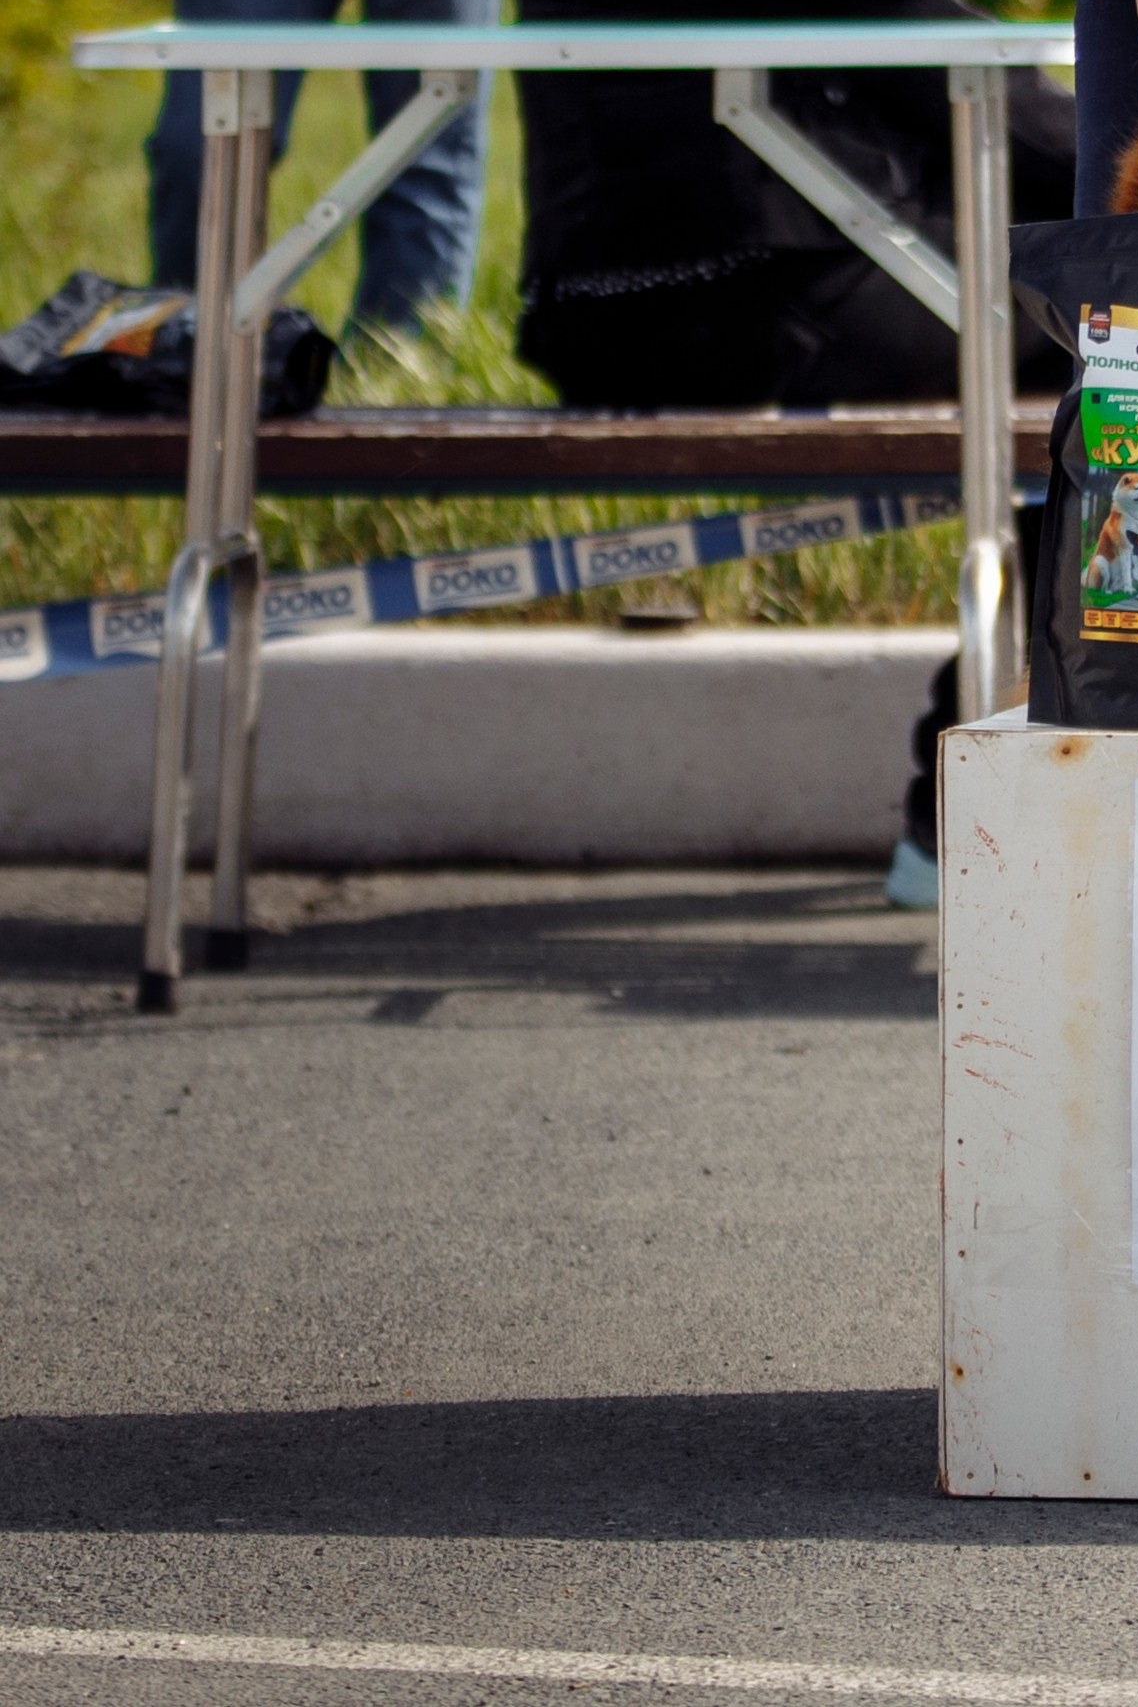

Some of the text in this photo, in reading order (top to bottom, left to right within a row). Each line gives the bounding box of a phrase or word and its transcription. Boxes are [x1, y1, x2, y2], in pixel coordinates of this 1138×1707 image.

[755, 515, 846, 549] DOKO
[590, 540, 679, 575] DOKO
[430, 563, 518, 593] DOKO
[263, 586, 351, 617] DOKO
